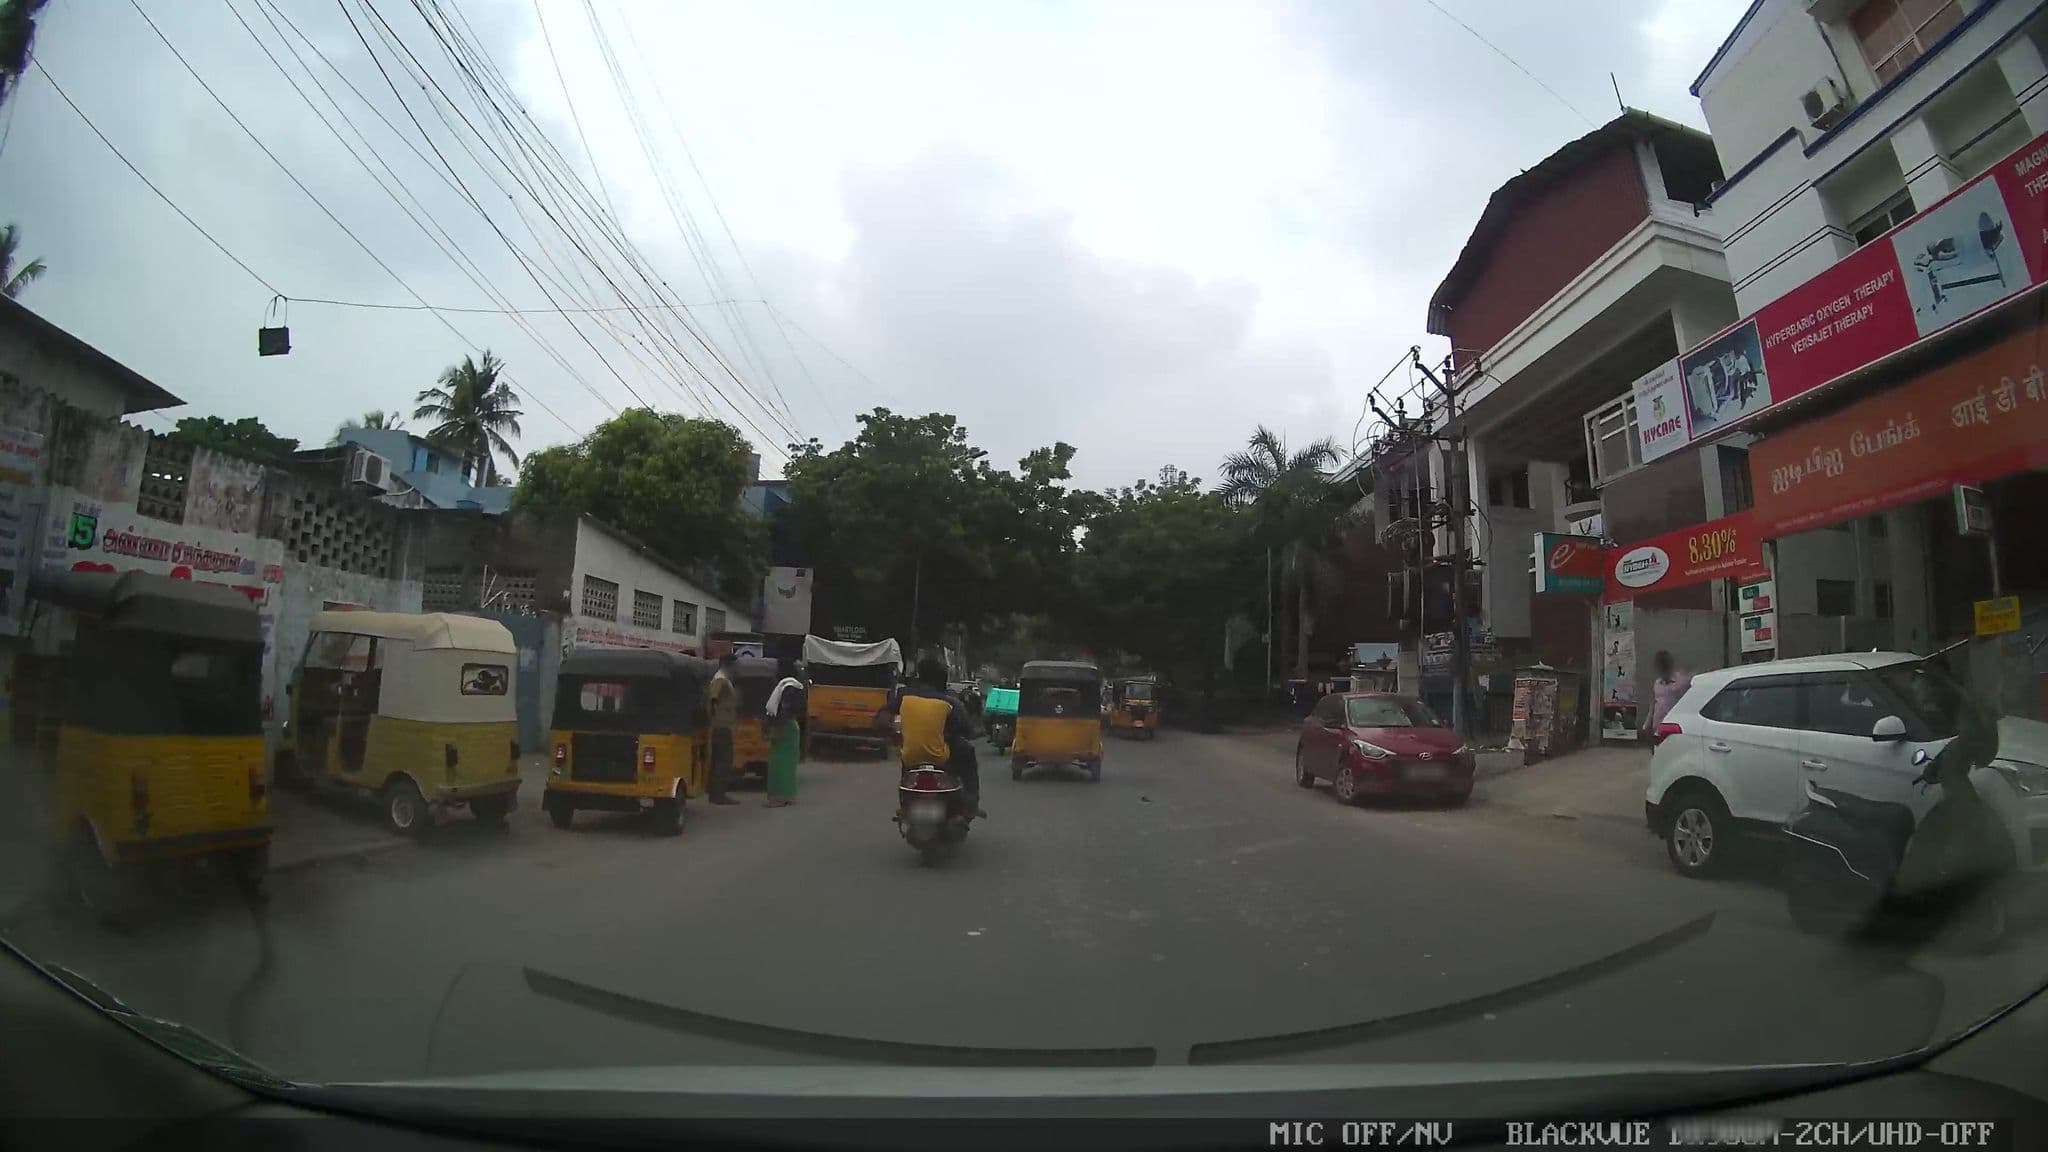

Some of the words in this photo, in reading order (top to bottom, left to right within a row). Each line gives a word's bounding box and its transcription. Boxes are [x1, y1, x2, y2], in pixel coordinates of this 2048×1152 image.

[1765, 313, 1816, 348] HYPERBARIC
[1816, 295, 1851, 321] OXYGEN
[1853, 269, 1895, 301] THERAPY
[1791, 326, 1833, 354] VERSAJET
[1833, 303, 1874, 333] THERAPY
[1643, 416, 1682, 444] HYCARE
